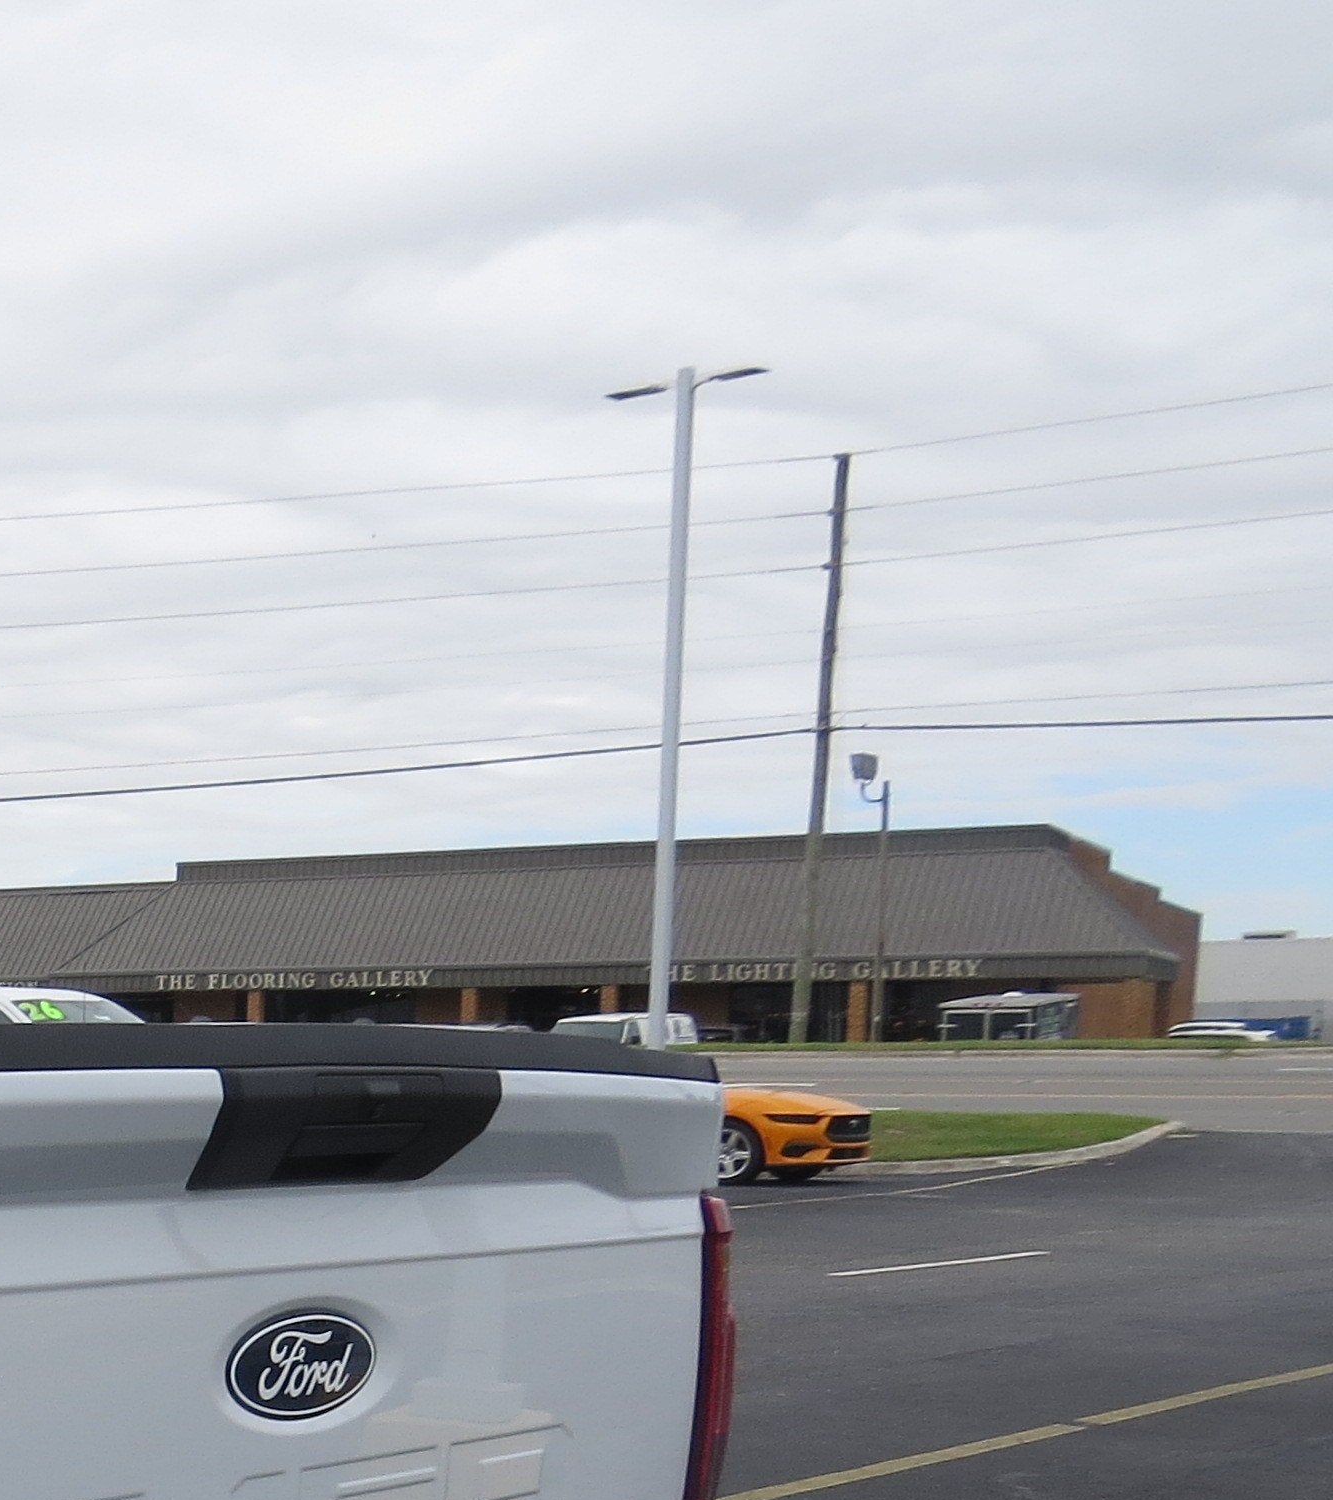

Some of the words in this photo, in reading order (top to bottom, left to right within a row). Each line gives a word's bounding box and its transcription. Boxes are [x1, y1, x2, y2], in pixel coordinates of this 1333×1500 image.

[156, 974, 196, 990] THE
[208, 972, 316, 990] FLOORING
[330, 969, 433, 989] GALLERY
[646, 964, 696, 982] HE
[18, 1000, 65, 1021] 26
[258, 1330, 354, 1400] Ford
